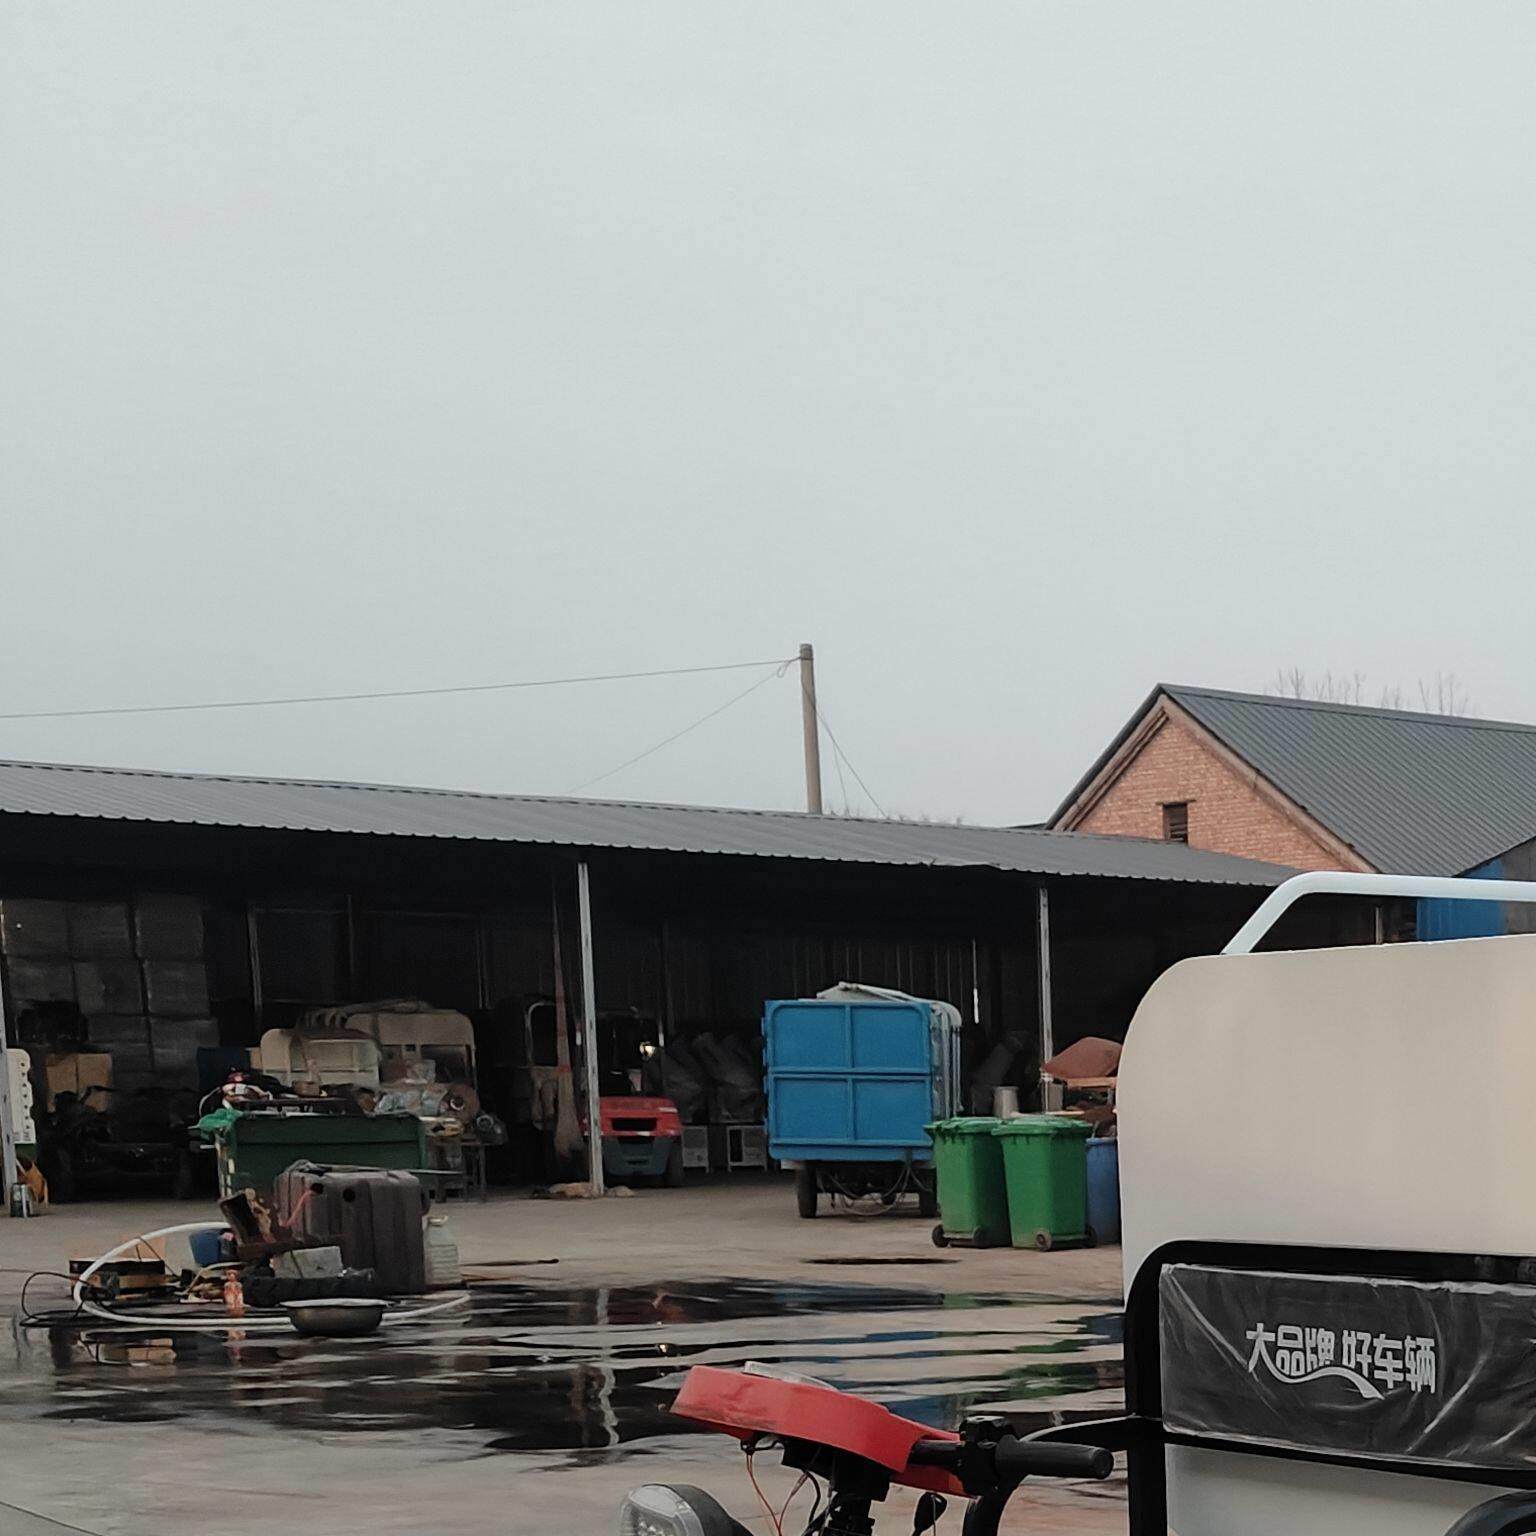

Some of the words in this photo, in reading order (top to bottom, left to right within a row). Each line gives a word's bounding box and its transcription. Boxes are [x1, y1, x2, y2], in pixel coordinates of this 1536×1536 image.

[1246, 1323, 1335, 1383] 大品牌
[1341, 1329, 1436, 1394] 好车辆
